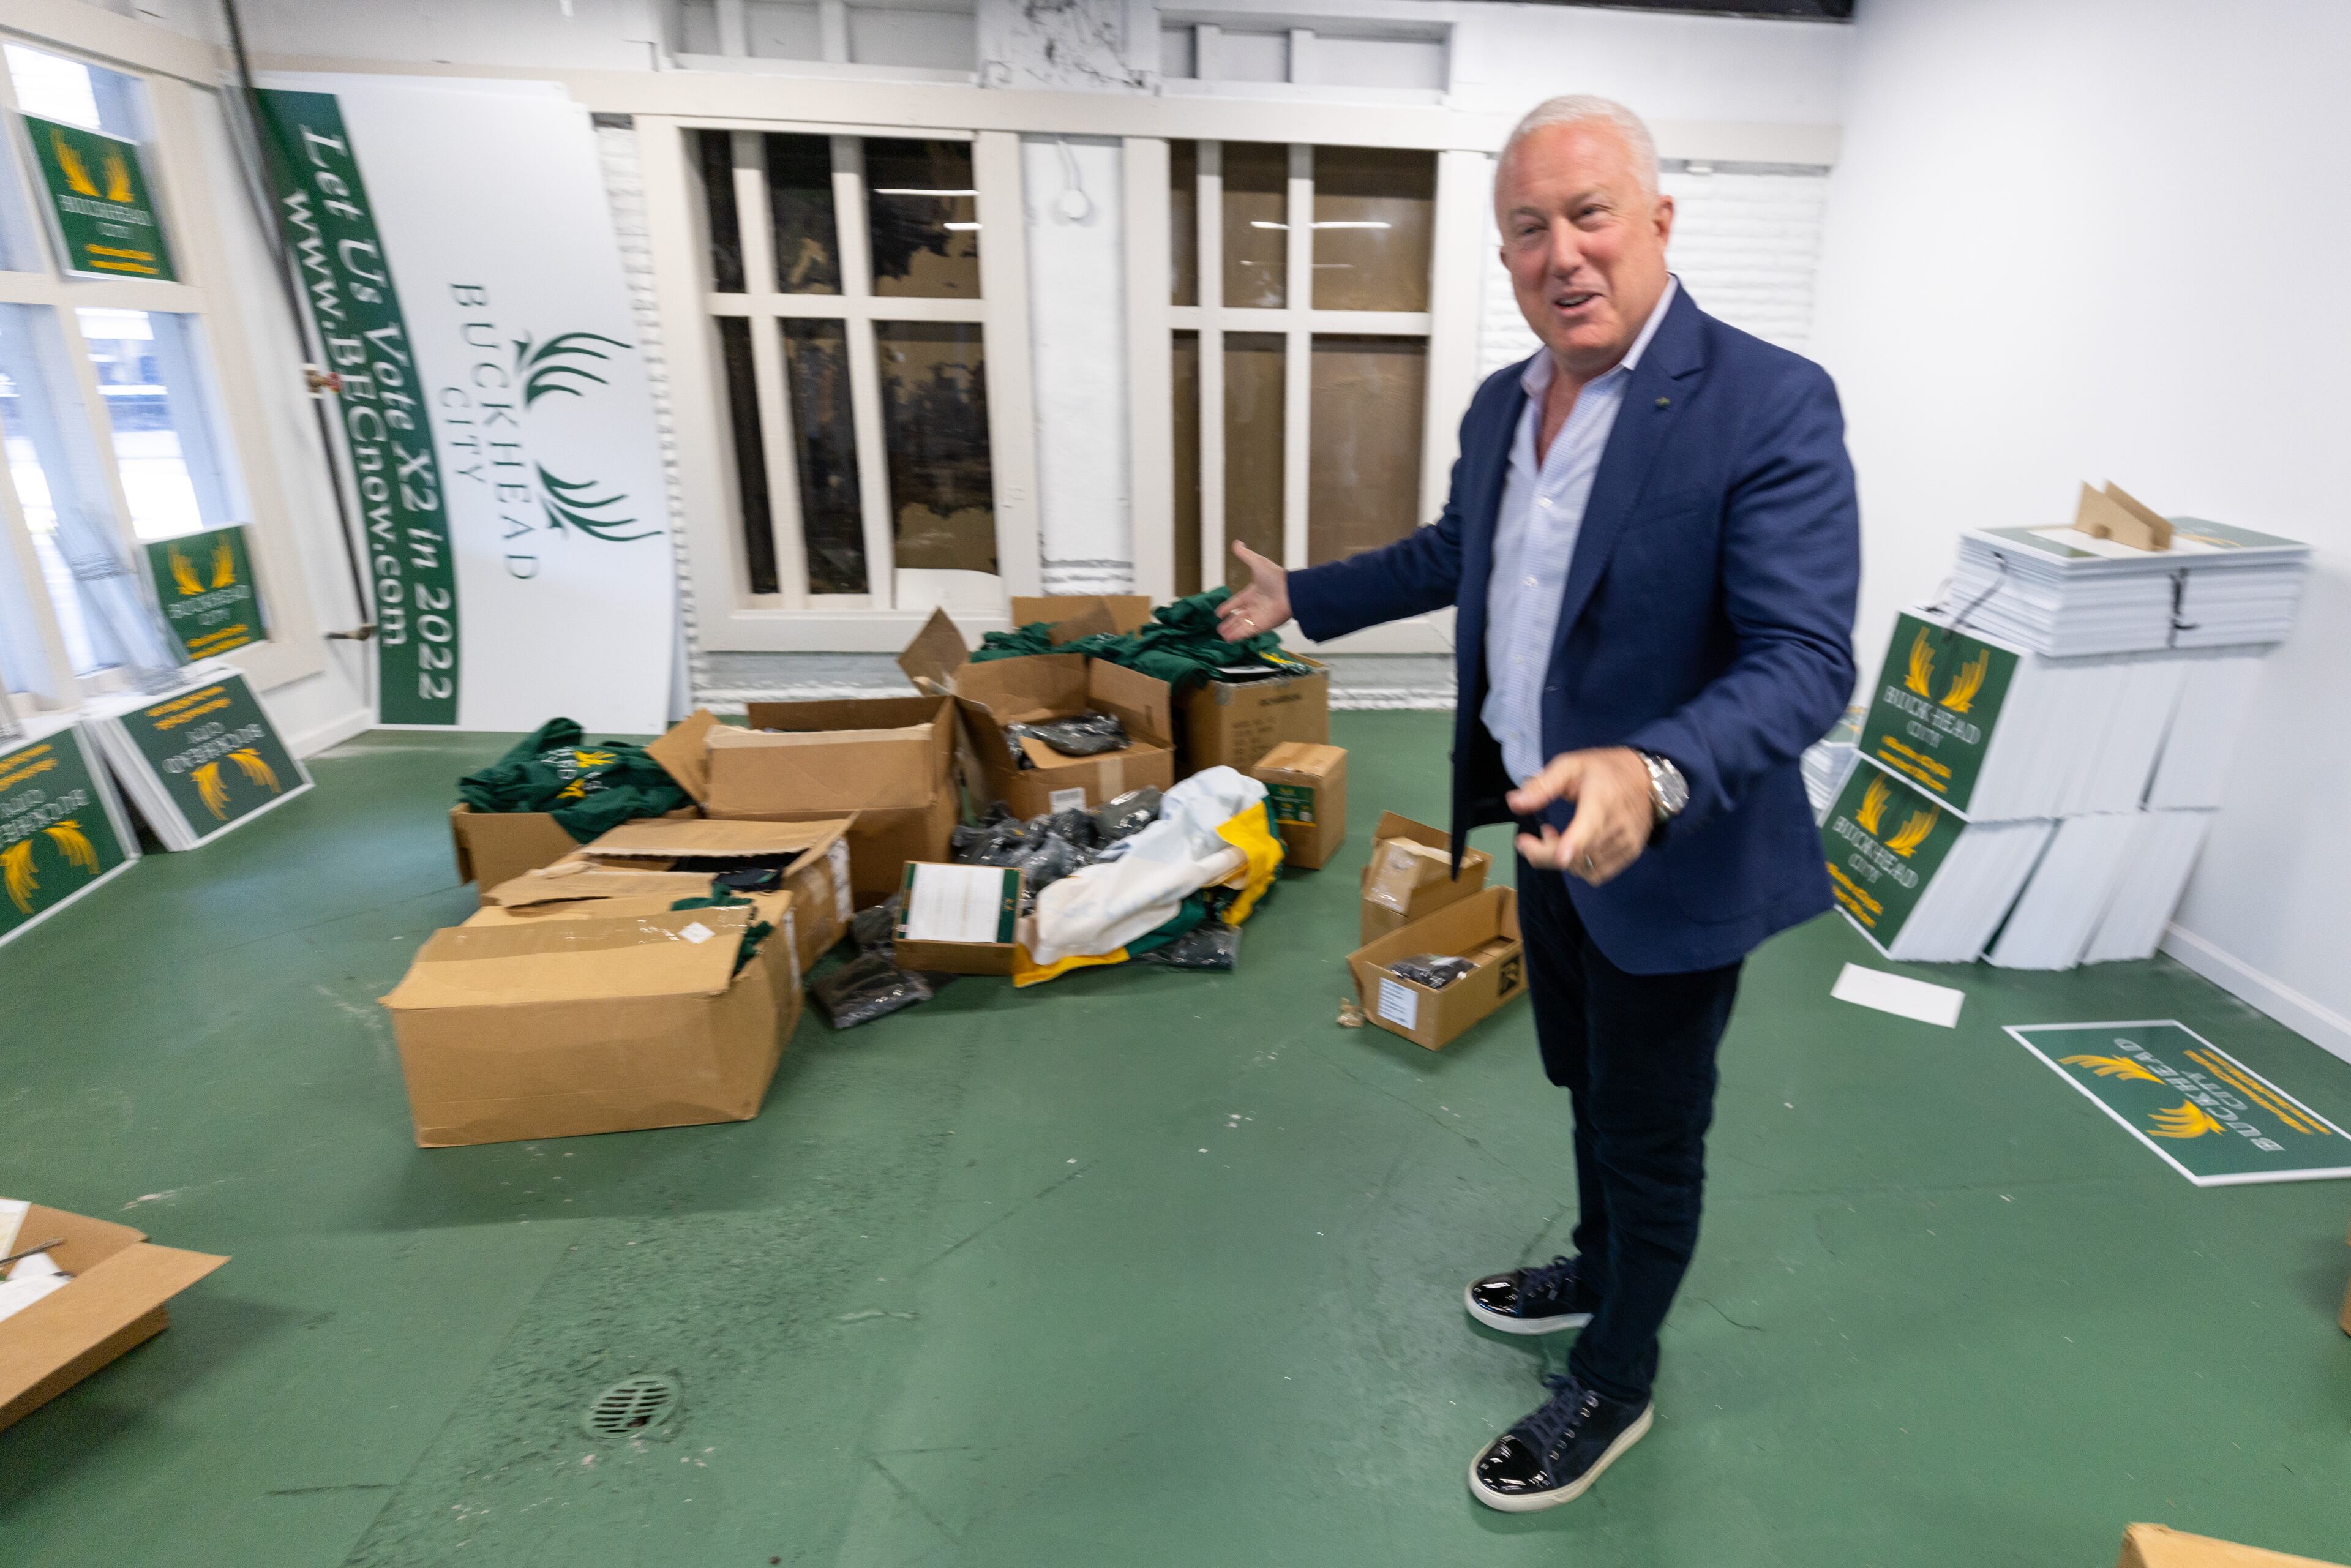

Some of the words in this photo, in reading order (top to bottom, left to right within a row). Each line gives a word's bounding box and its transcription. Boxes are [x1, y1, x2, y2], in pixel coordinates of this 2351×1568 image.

[299, 124, 364, 222] Let
[337, 239, 389, 304] Us
[364, 321, 416, 430] Vote
[282, 187, 407, 647] www.BECnow.com
[438, 386, 485, 484] CITY
[449, 282, 540, 579] BUCKHEAD
[391, 441, 438, 512] X2
[407, 528, 443, 569] in
[414, 582, 453, 700] 2022
[1883, 685, 1981, 745] BUCKHEAD
[1906, 719, 1944, 748] CITY
[1832, 815, 1919, 888] BUCKHEAD
[1848, 853, 1883, 883] CITY
[2114, 1038, 2286, 1152] BUCKHEAD
[2180, 1070, 2248, 1111] CITY
